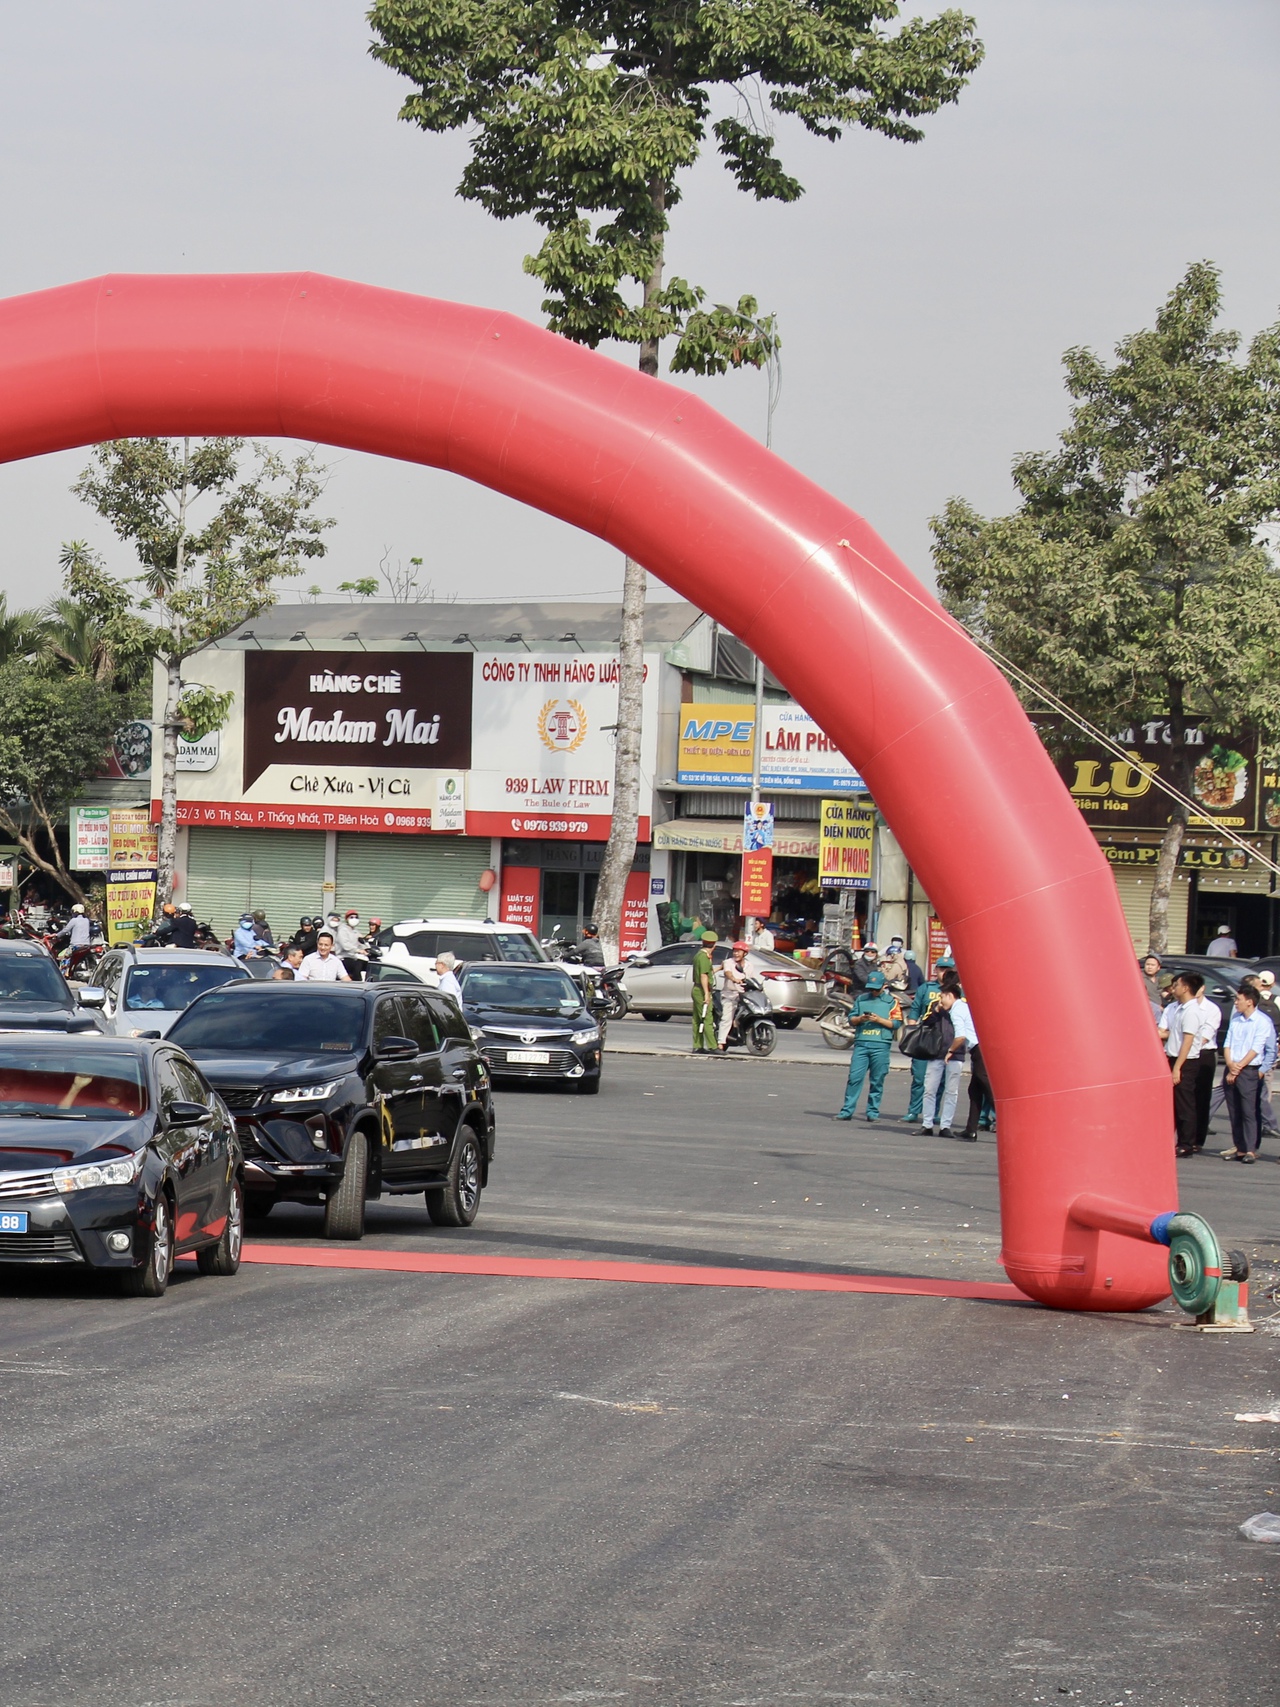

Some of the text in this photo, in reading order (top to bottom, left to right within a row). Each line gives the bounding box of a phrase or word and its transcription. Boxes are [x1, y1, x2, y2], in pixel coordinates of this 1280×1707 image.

[482, 658, 514, 682] CÔNG
[518, 663, 531, 682] TY
[534, 663, 560, 682] TNHH
[564, 660, 595, 683] HÃNG
[310, 669, 401, 694] HÀNG CHÈ
[274, 707, 440, 746] Madam Mai
[682, 720, 755, 742] MPE
[766, 728, 800, 750] LÂM
[200, 746, 216, 756] MAI
[290, 775, 411, 799] Chè Xưa Vị Cũ
[506, 778, 610, 796] 939 LAW FIRM
[524, 799, 590, 808] The Rule of Law
[1104, 799, 1128, 811] Hòa
[204, 810, 216, 820] Võ
[219, 810, 232, 822] Thị
[235, 808, 254, 822] Sáu,
[298, 811, 320, 825] Nhất,
[338, 812, 358, 826] Biên
[396, 816, 416, 827] 0968
[826, 804, 844, 820] CỬA
[113, 823, 127, 834] HEO
[524, 820, 588, 832] 0976 939 979
[824, 824, 870, 840] ĐIỆN NƯỚC
[823, 844, 869, 873] LÂM PHONG
[118, 886, 130, 902] TIẾU
[507, 894, 524, 903] LUẬT
[126, 902, 138, 919] LẨU
[508, 903, 520, 912] DÂN
[627, 900, 638, 908] TƯ
[506, 912, 522, 922] HÌNH
[625, 909, 643, 918] PHÁP
[623, 939, 639, 948] PHÁP
